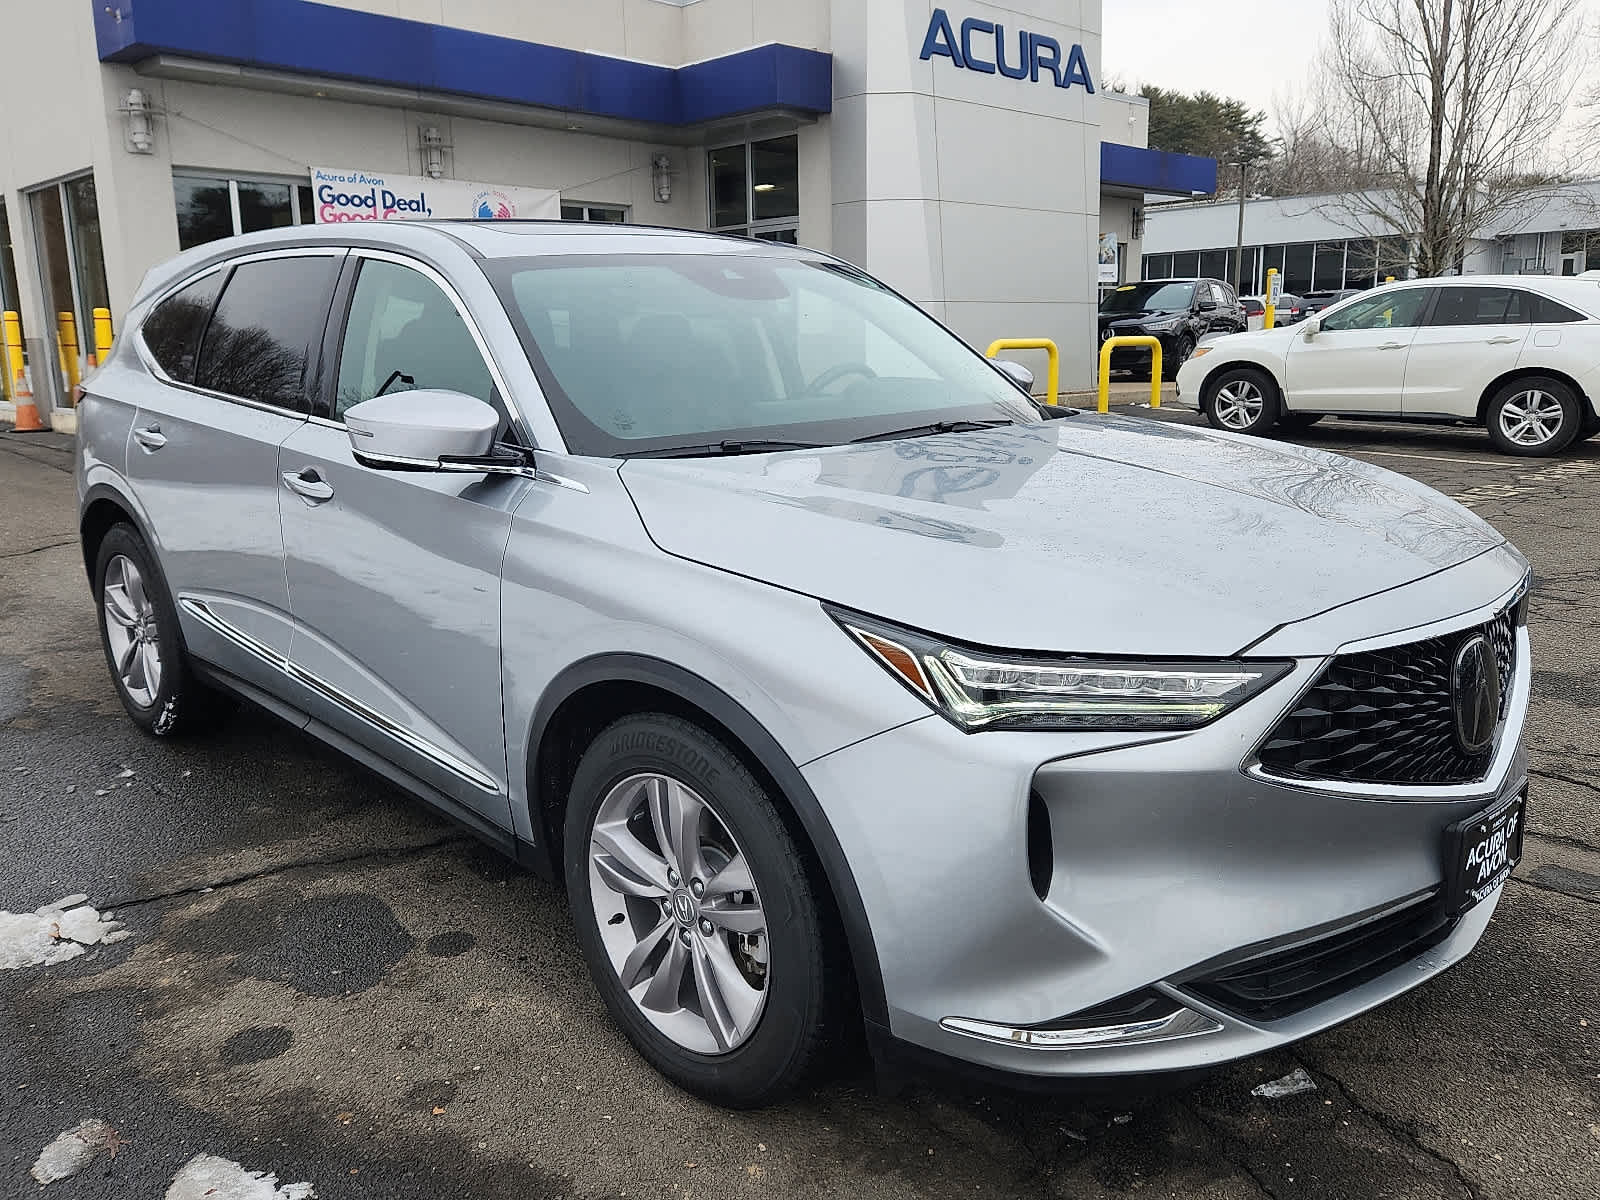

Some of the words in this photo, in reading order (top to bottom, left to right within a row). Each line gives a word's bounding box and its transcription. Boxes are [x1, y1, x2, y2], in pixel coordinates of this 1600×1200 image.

[919, 8, 1095, 94] ACURA
[316, 170, 345, 182] Acura
[347, 173, 357, 183] of
[359, 175, 384, 186] Avon
[318, 184, 376, 208] Good
[381, 189, 432, 217] Deal,
[1465, 826, 1504, 871] ACURA
[1506, 811, 1518, 839] OF
[1476, 841, 1508, 883] AVON
